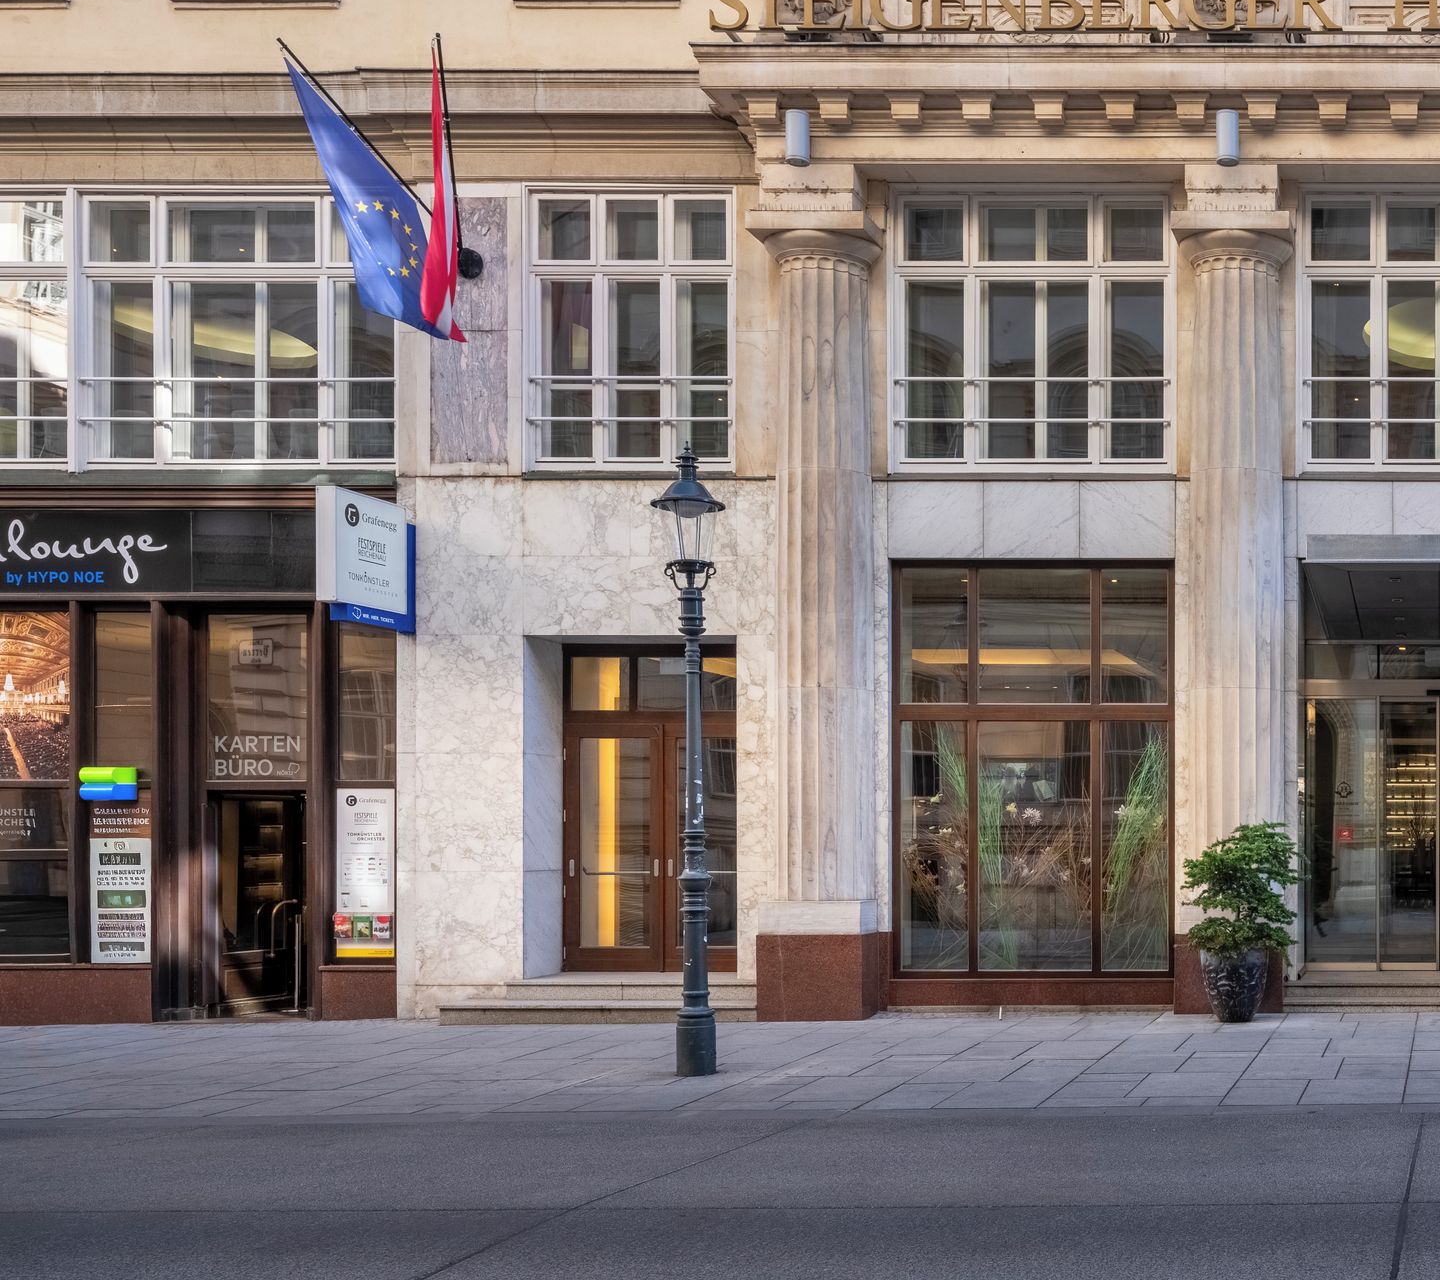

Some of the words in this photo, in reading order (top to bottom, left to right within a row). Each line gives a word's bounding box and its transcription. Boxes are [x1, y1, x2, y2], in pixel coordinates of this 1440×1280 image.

[361, 513, 398, 532] Grafenegg
[358, 537, 387, 555] FESTSPIELE
[358, 548, 387, 562] REICHENAU
[6, 571, 23, 585] by
[28, 571, 69, 583] HYPO
[74, 571, 104, 583] NOE
[214, 736, 300, 753] KARTEN
[215, 755, 273, 776] BÜRO
